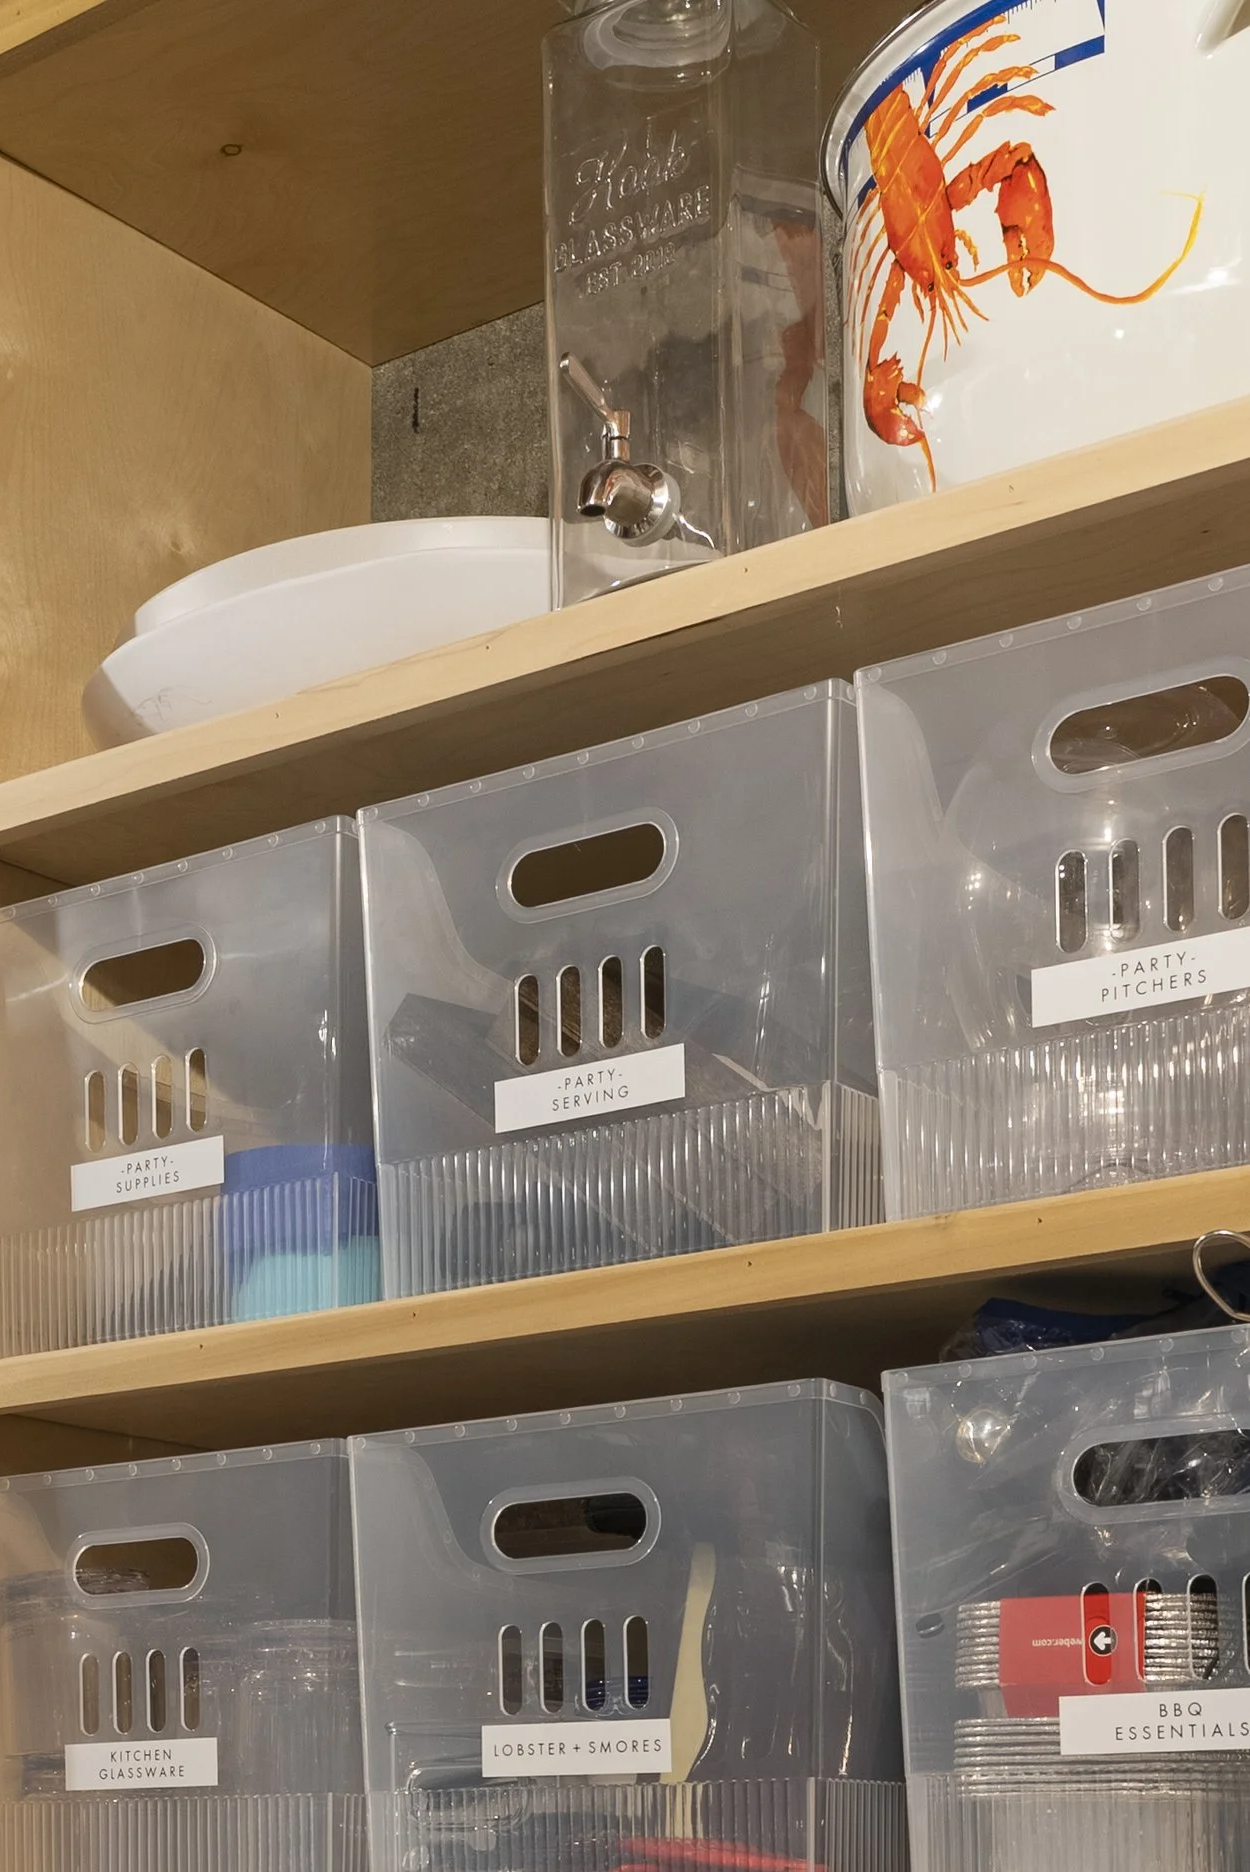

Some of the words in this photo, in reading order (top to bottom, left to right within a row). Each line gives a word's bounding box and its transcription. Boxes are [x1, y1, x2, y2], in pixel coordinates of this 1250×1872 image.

[1102, 970, 1207, 1002] PITCHERS
[552, 1085, 629, 1111] SERVING
[116, 1171, 180, 1193] SUPPLIES
[1159, 1702, 1203, 1717] BBQ
[1115, 1722, 1250, 1740] ESSENTIALS
[111, 1749, 171, 1762] KITCHEN
[494, 1742, 565, 1757] LOBSTER
[589, 1739, 661, 1754] SMORES
[99, 1766, 184, 1780] GLASSWARE
